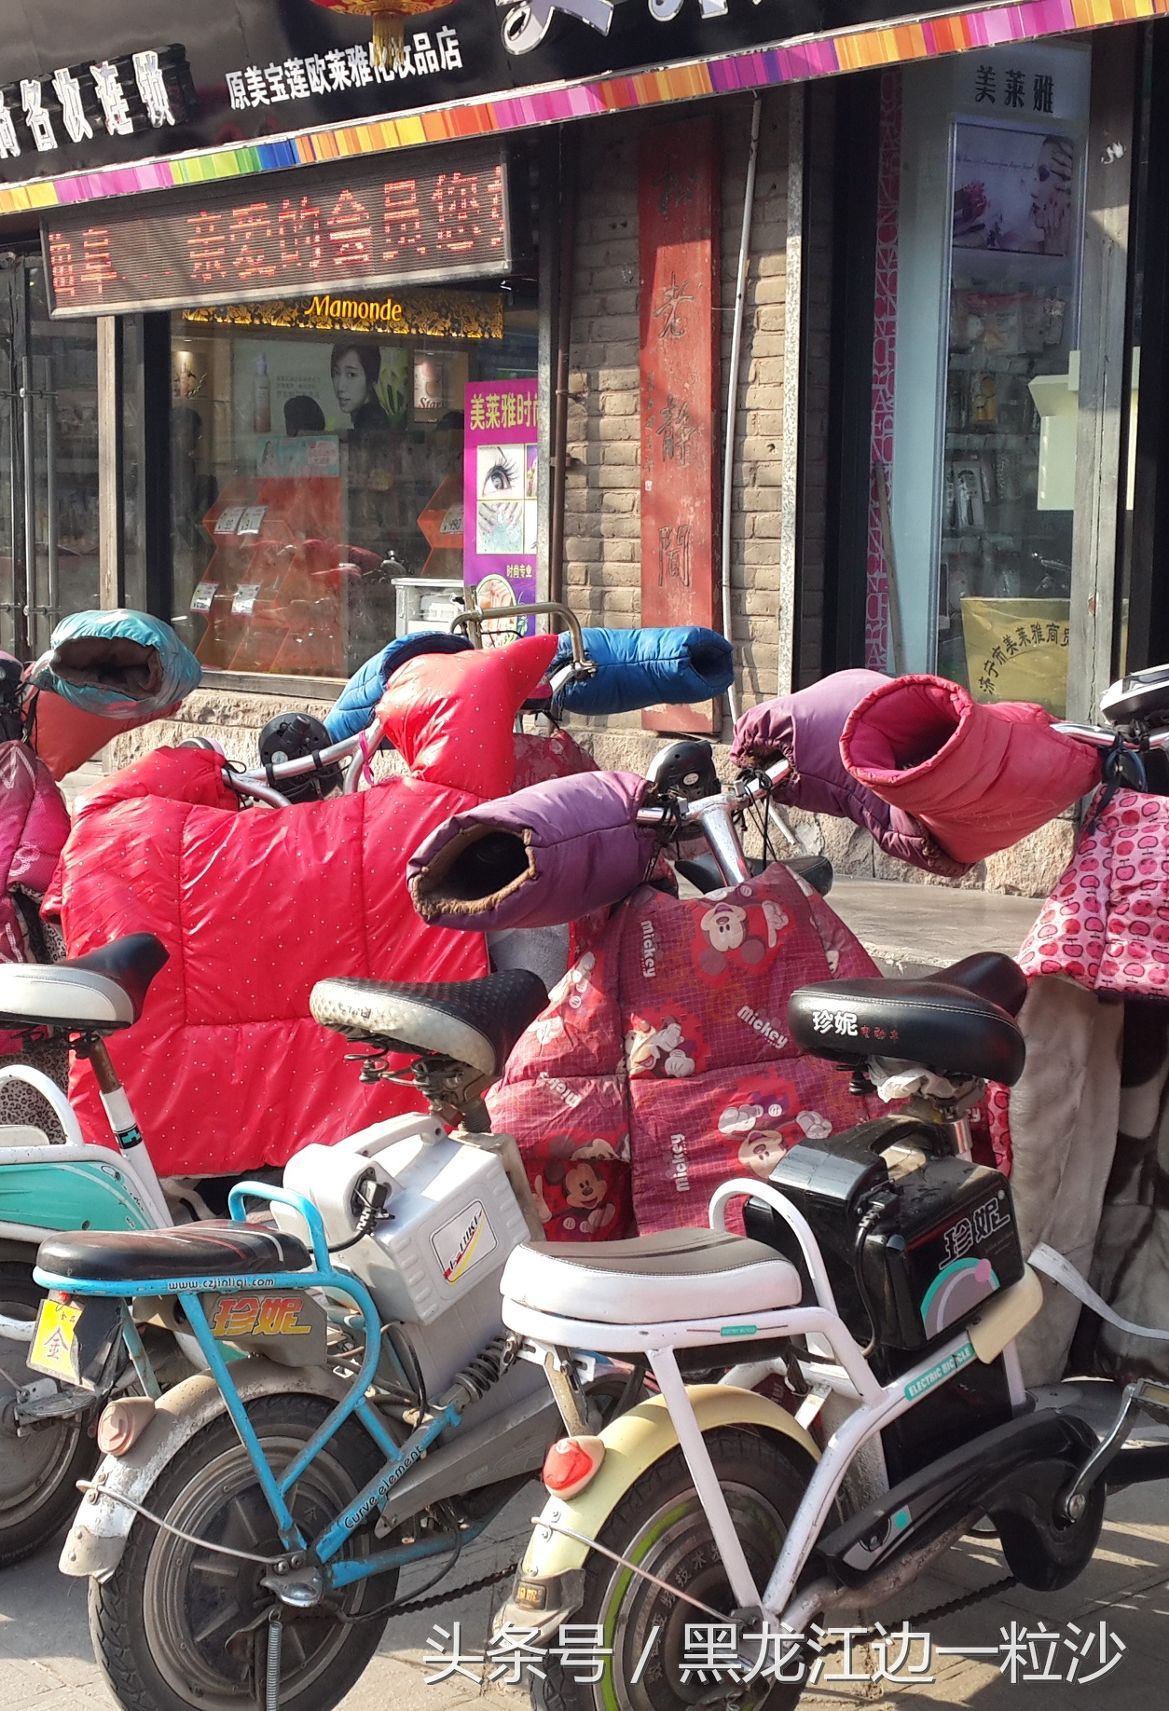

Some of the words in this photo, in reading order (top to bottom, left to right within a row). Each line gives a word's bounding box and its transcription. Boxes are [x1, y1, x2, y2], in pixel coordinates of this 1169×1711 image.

[975, 64, 1055, 114] 美莱雅
[304, 295, 402, 322] Mamonde
[640, 919, 657, 979] mickey
[736, 1005, 789, 1050] mickey
[812, 1009, 858, 1036] 珍妮
[670, 1133, 690, 1192] mickey
[938, 1197, 1011, 1271] 珍妮
[211, 1296, 313, 1336] 珍妮
[344, 1494, 378, 1530] Curve
[377, 1445, 425, 1496] element
